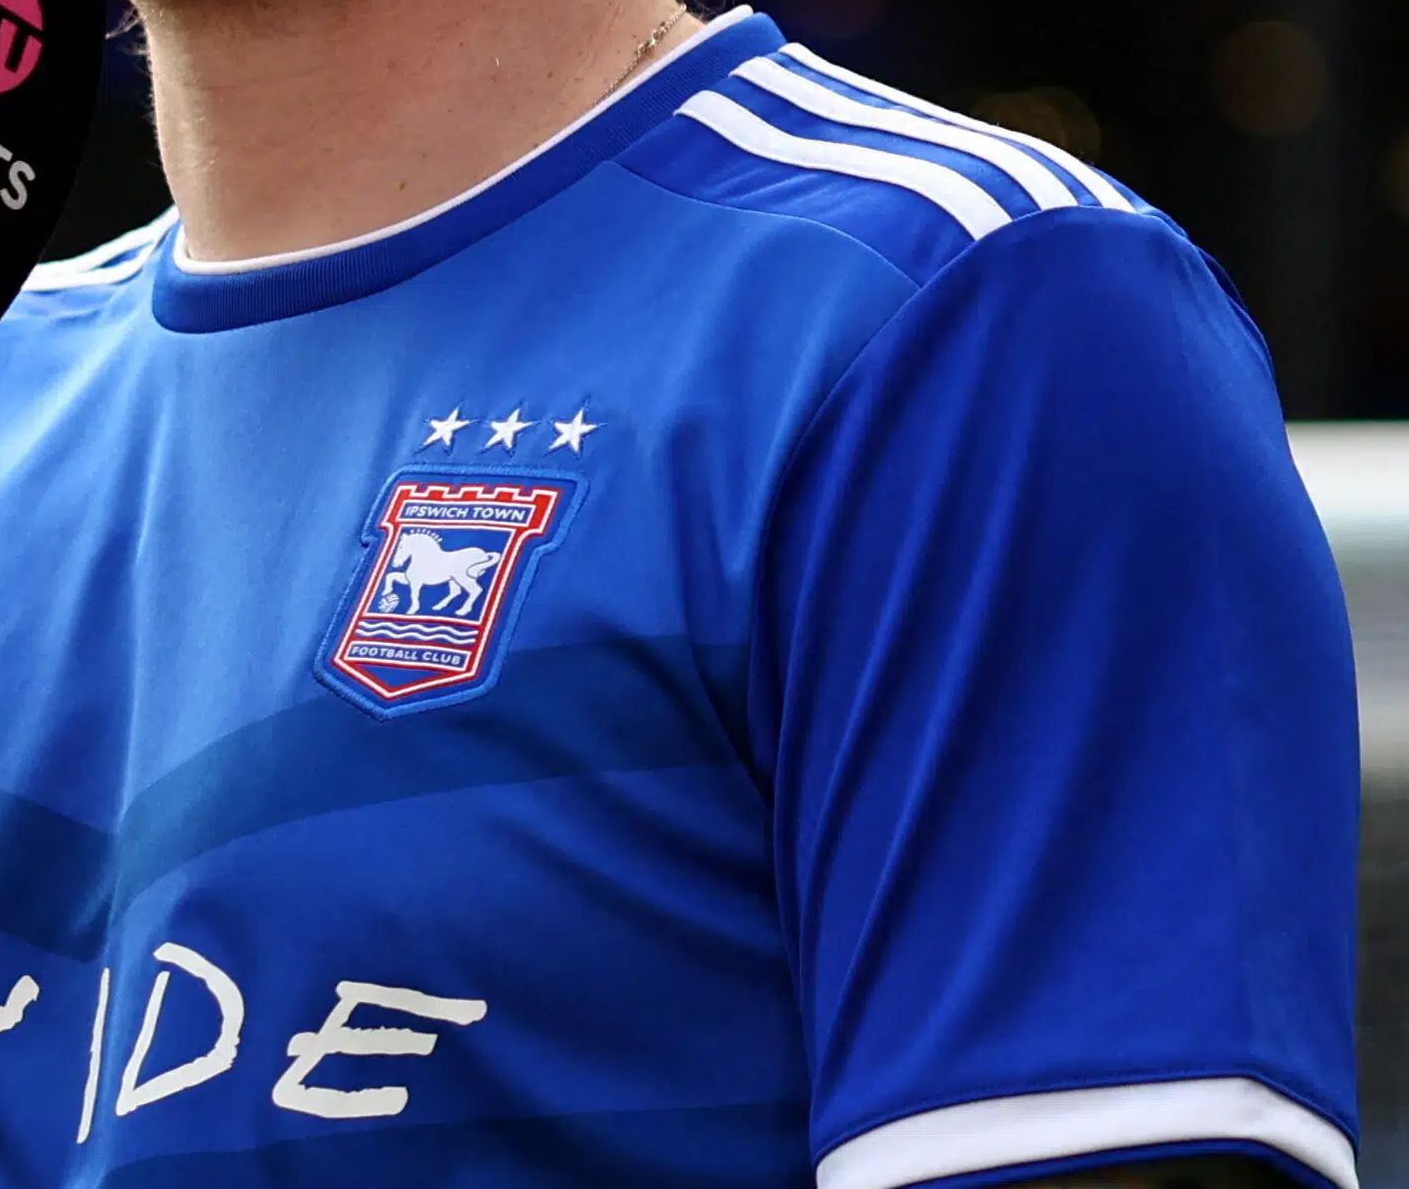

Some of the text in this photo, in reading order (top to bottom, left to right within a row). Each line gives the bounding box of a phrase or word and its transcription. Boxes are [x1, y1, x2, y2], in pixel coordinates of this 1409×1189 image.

[405, 505, 526, 521] IPSWICH TOWN
[351, 646, 462, 665] FOOTBALL CLUB
